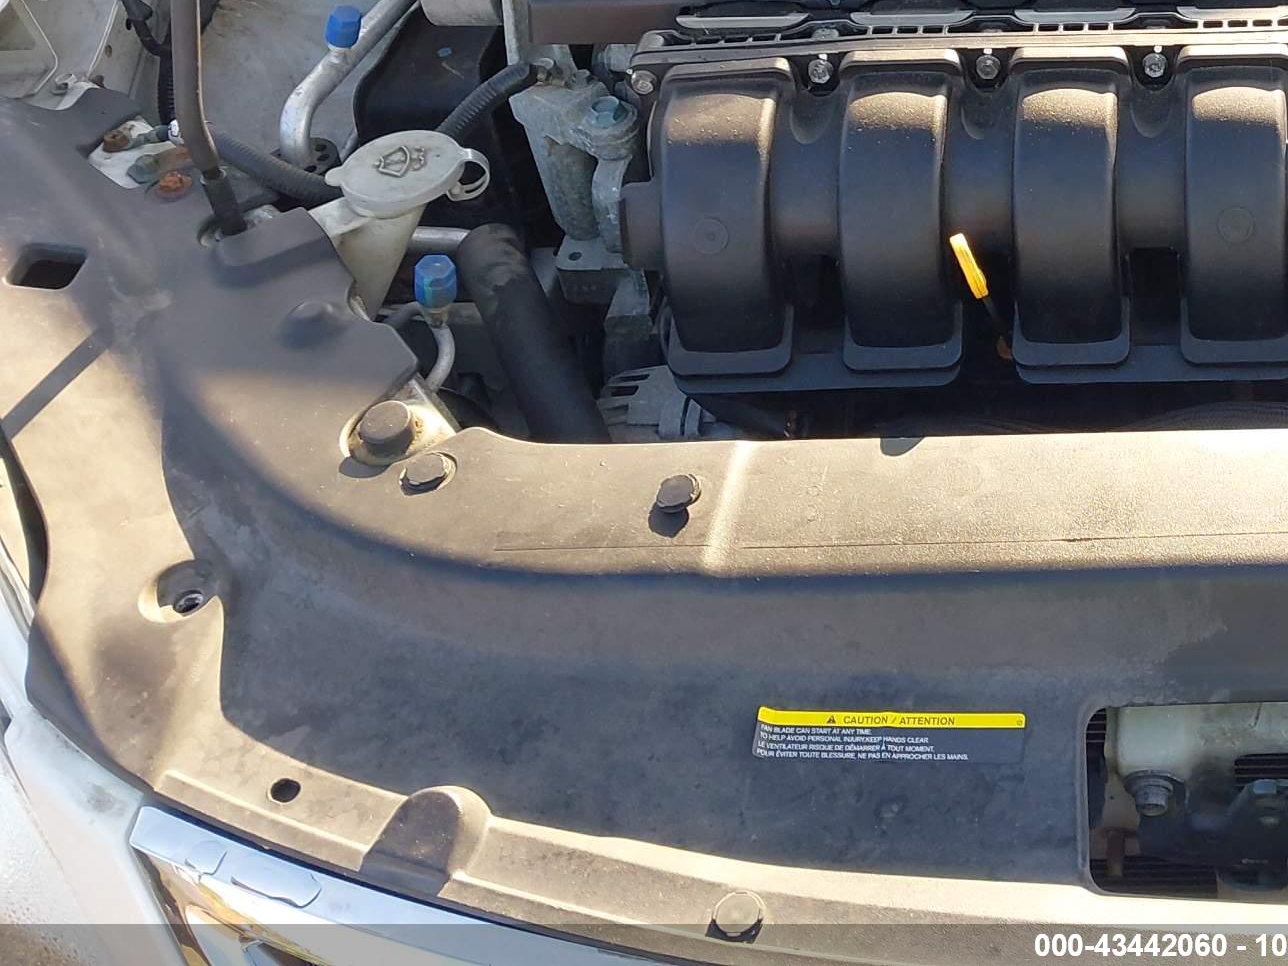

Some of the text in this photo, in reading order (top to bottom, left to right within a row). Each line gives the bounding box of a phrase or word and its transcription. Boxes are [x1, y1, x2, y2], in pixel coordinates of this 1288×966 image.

[843, 715, 888, 725] CAUTION
[899, 717, 955, 726] ATTENTION
[760, 724, 773, 733] FAN
[795, 727, 810, 735] CAN
[760, 732, 768, 740] TO
[786, 734, 807, 742] AVOID
[807, 735, 842, 743] PERSONAL
[883, 736, 906, 744] HANDS
[907, 736, 929, 744] CLEAR
[758, 740, 766, 748] LE
[766, 742, 808, 751] VENTILATEUR
[808, 744, 833, 752] RISQUE
[844, 743, 880, 752] DÉMARRER
[757, 748, 775, 757] POUR
[776, 749, 798, 758] ÉVITER
[799, 751, 820, 759] TOUTE
[858, 752, 867, 760] NE
[867, 752, 881, 760] PAS
[892, 753, 932, 761] APPROCHER
[933, 753, 946, 761] LES
